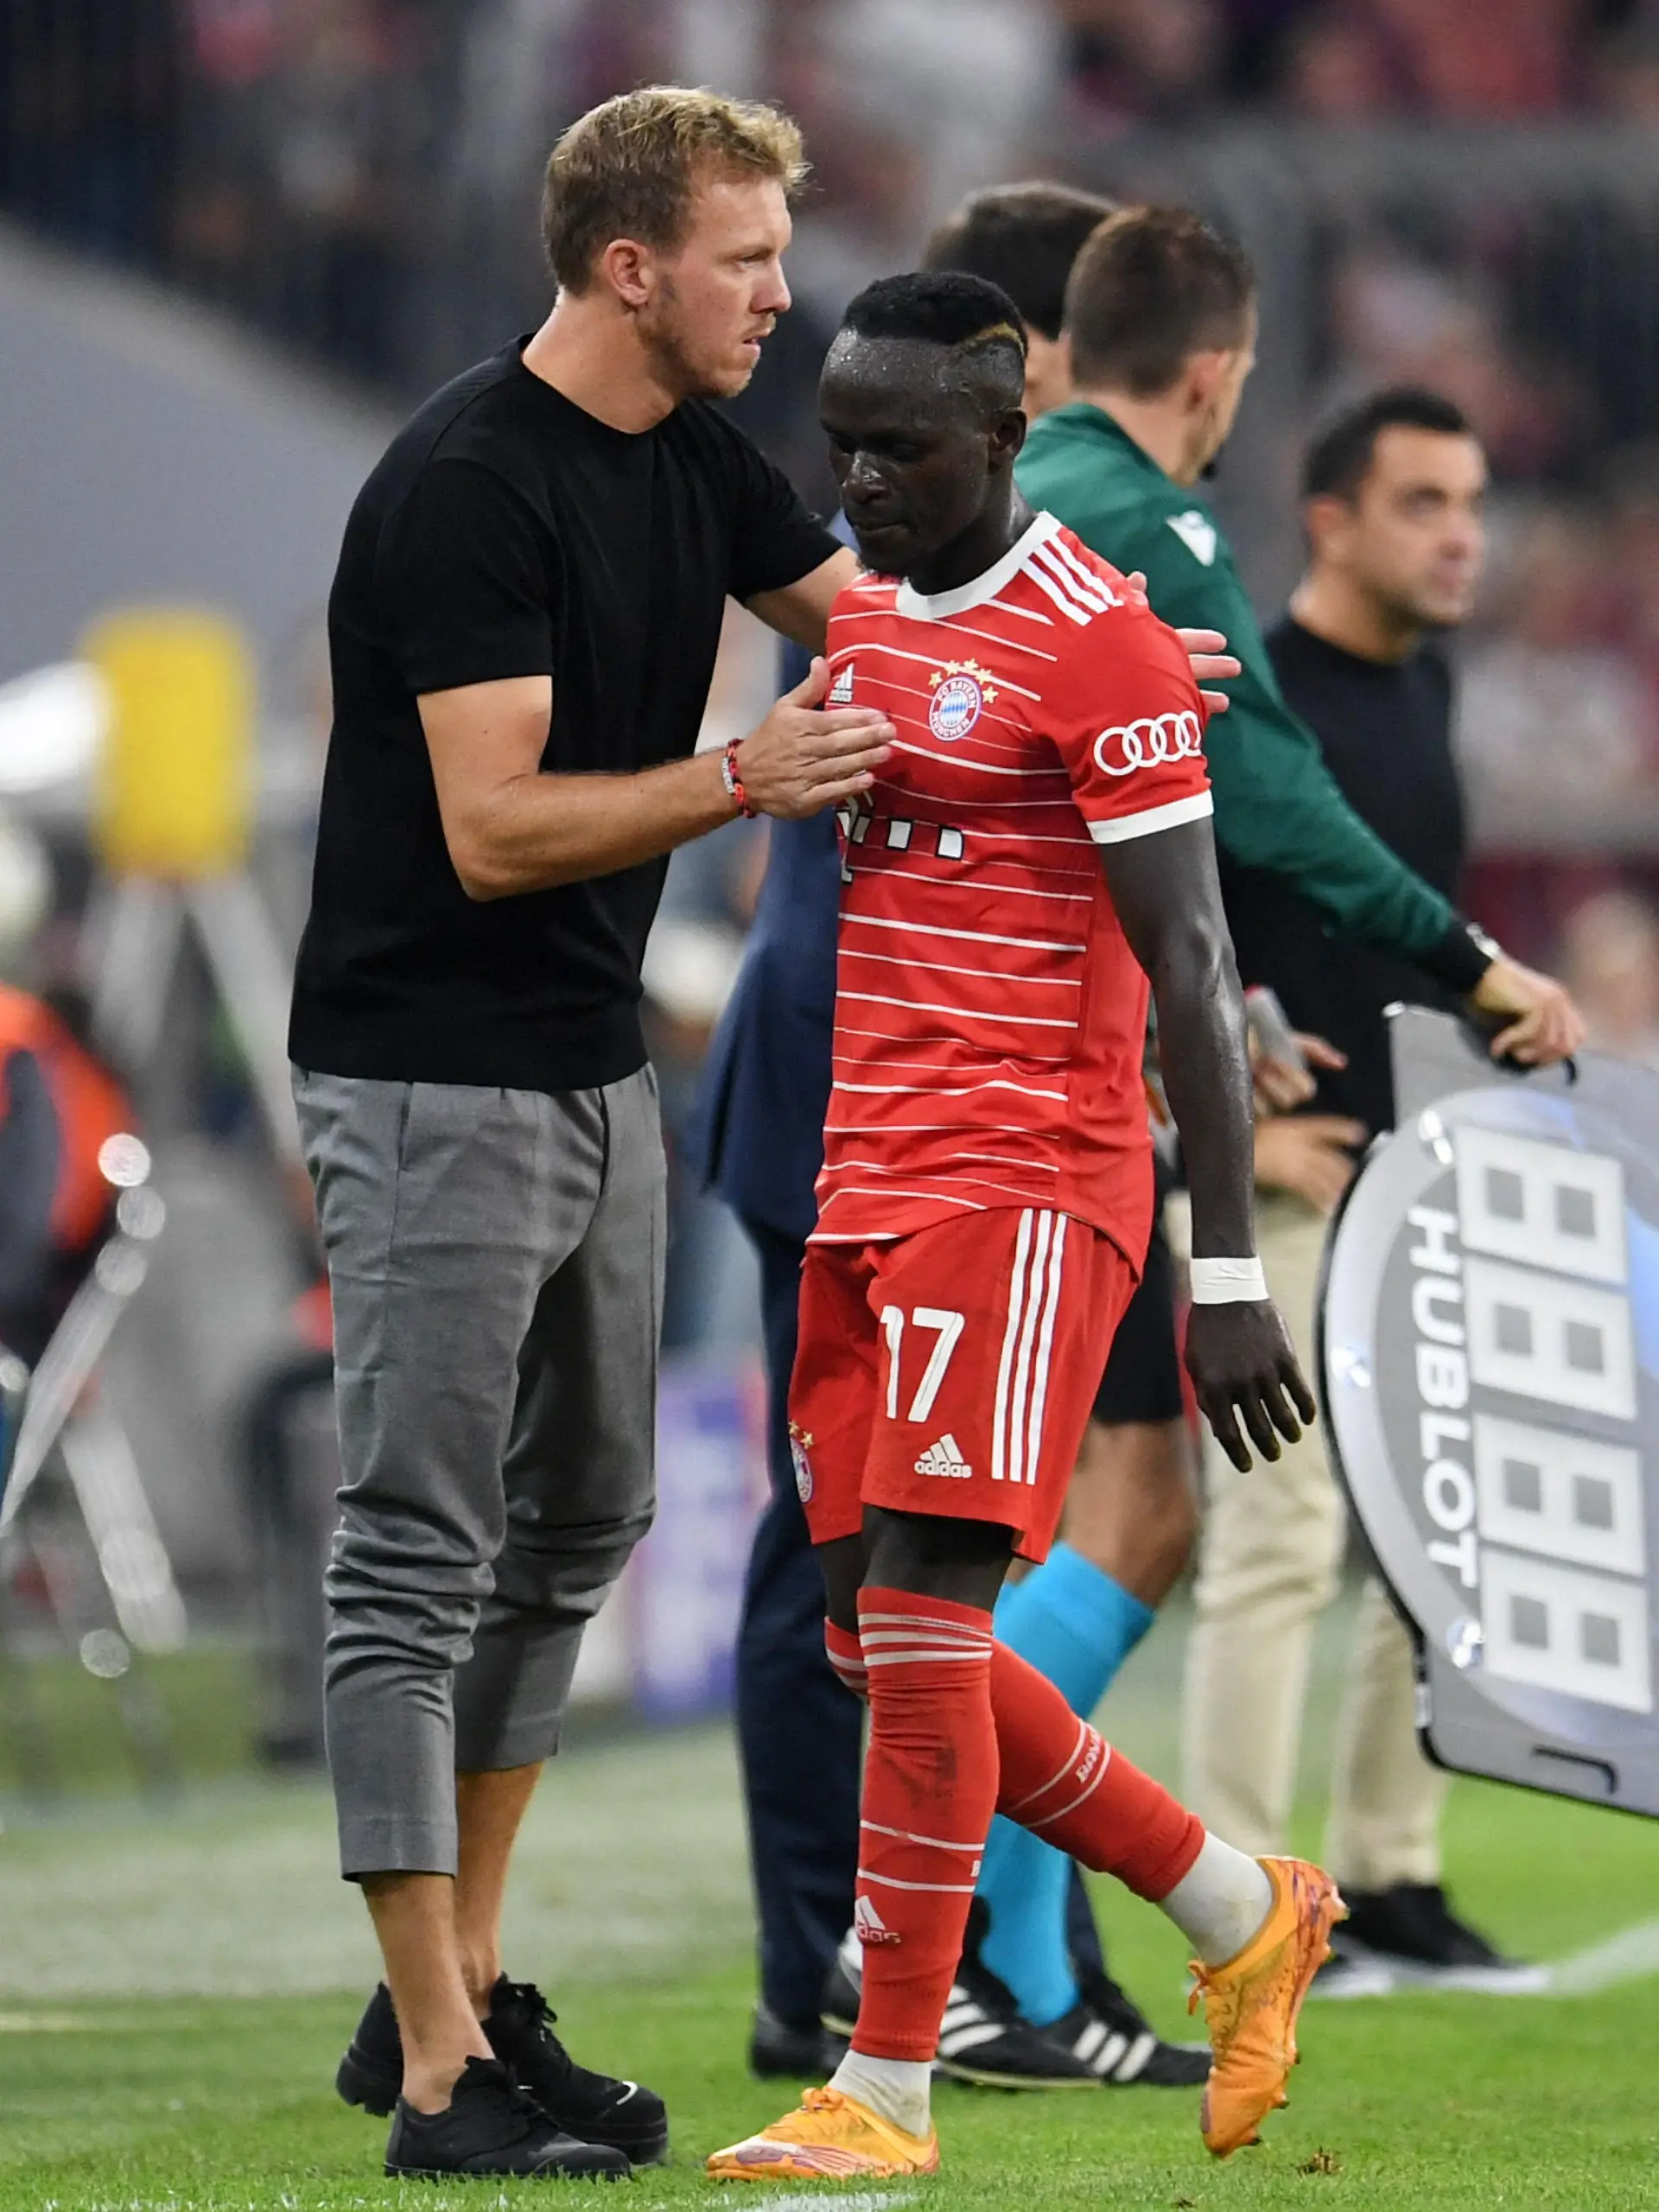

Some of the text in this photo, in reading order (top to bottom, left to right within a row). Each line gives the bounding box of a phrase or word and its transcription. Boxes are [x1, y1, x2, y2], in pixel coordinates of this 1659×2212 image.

[880, 1305, 965, 1423] 17
[1408, 1205, 1478, 1586] HUBLOT
[914, 1458, 973, 1478] adidas
